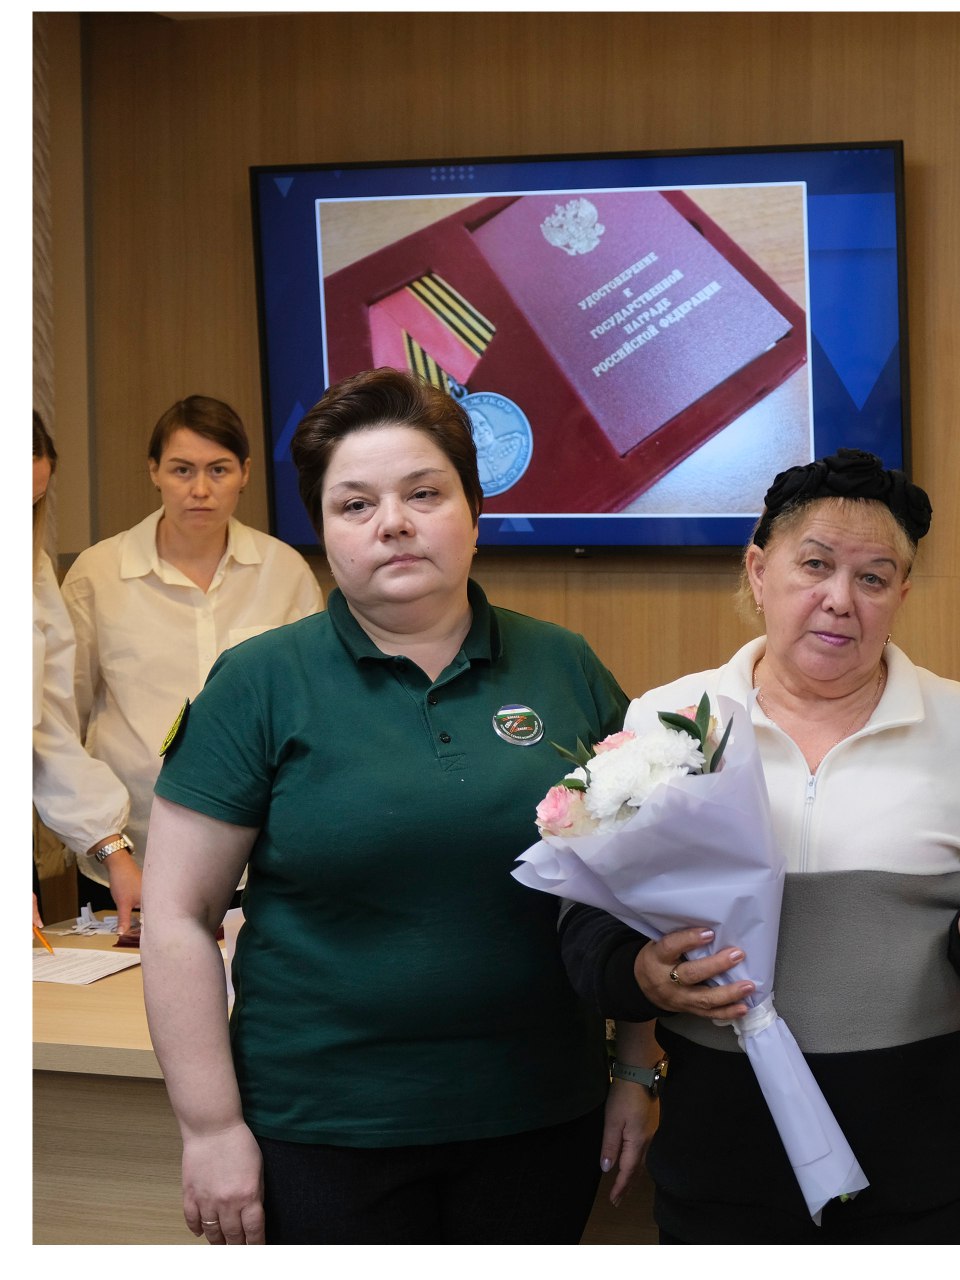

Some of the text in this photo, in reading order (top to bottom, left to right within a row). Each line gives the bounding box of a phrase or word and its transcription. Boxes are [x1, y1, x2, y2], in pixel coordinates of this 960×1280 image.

[577, 251, 658, 310] УДОСТОВЕРЕНИЕ
[590, 268, 684, 339] ГОСУДАРСТВЕННОЙ
[622, 287, 633, 298] К
[592, 280, 722, 377] РОССИЙСКОЙ ФЕДЕРАЦИИ
[623, 297, 671, 335] НАГРАДЕ
